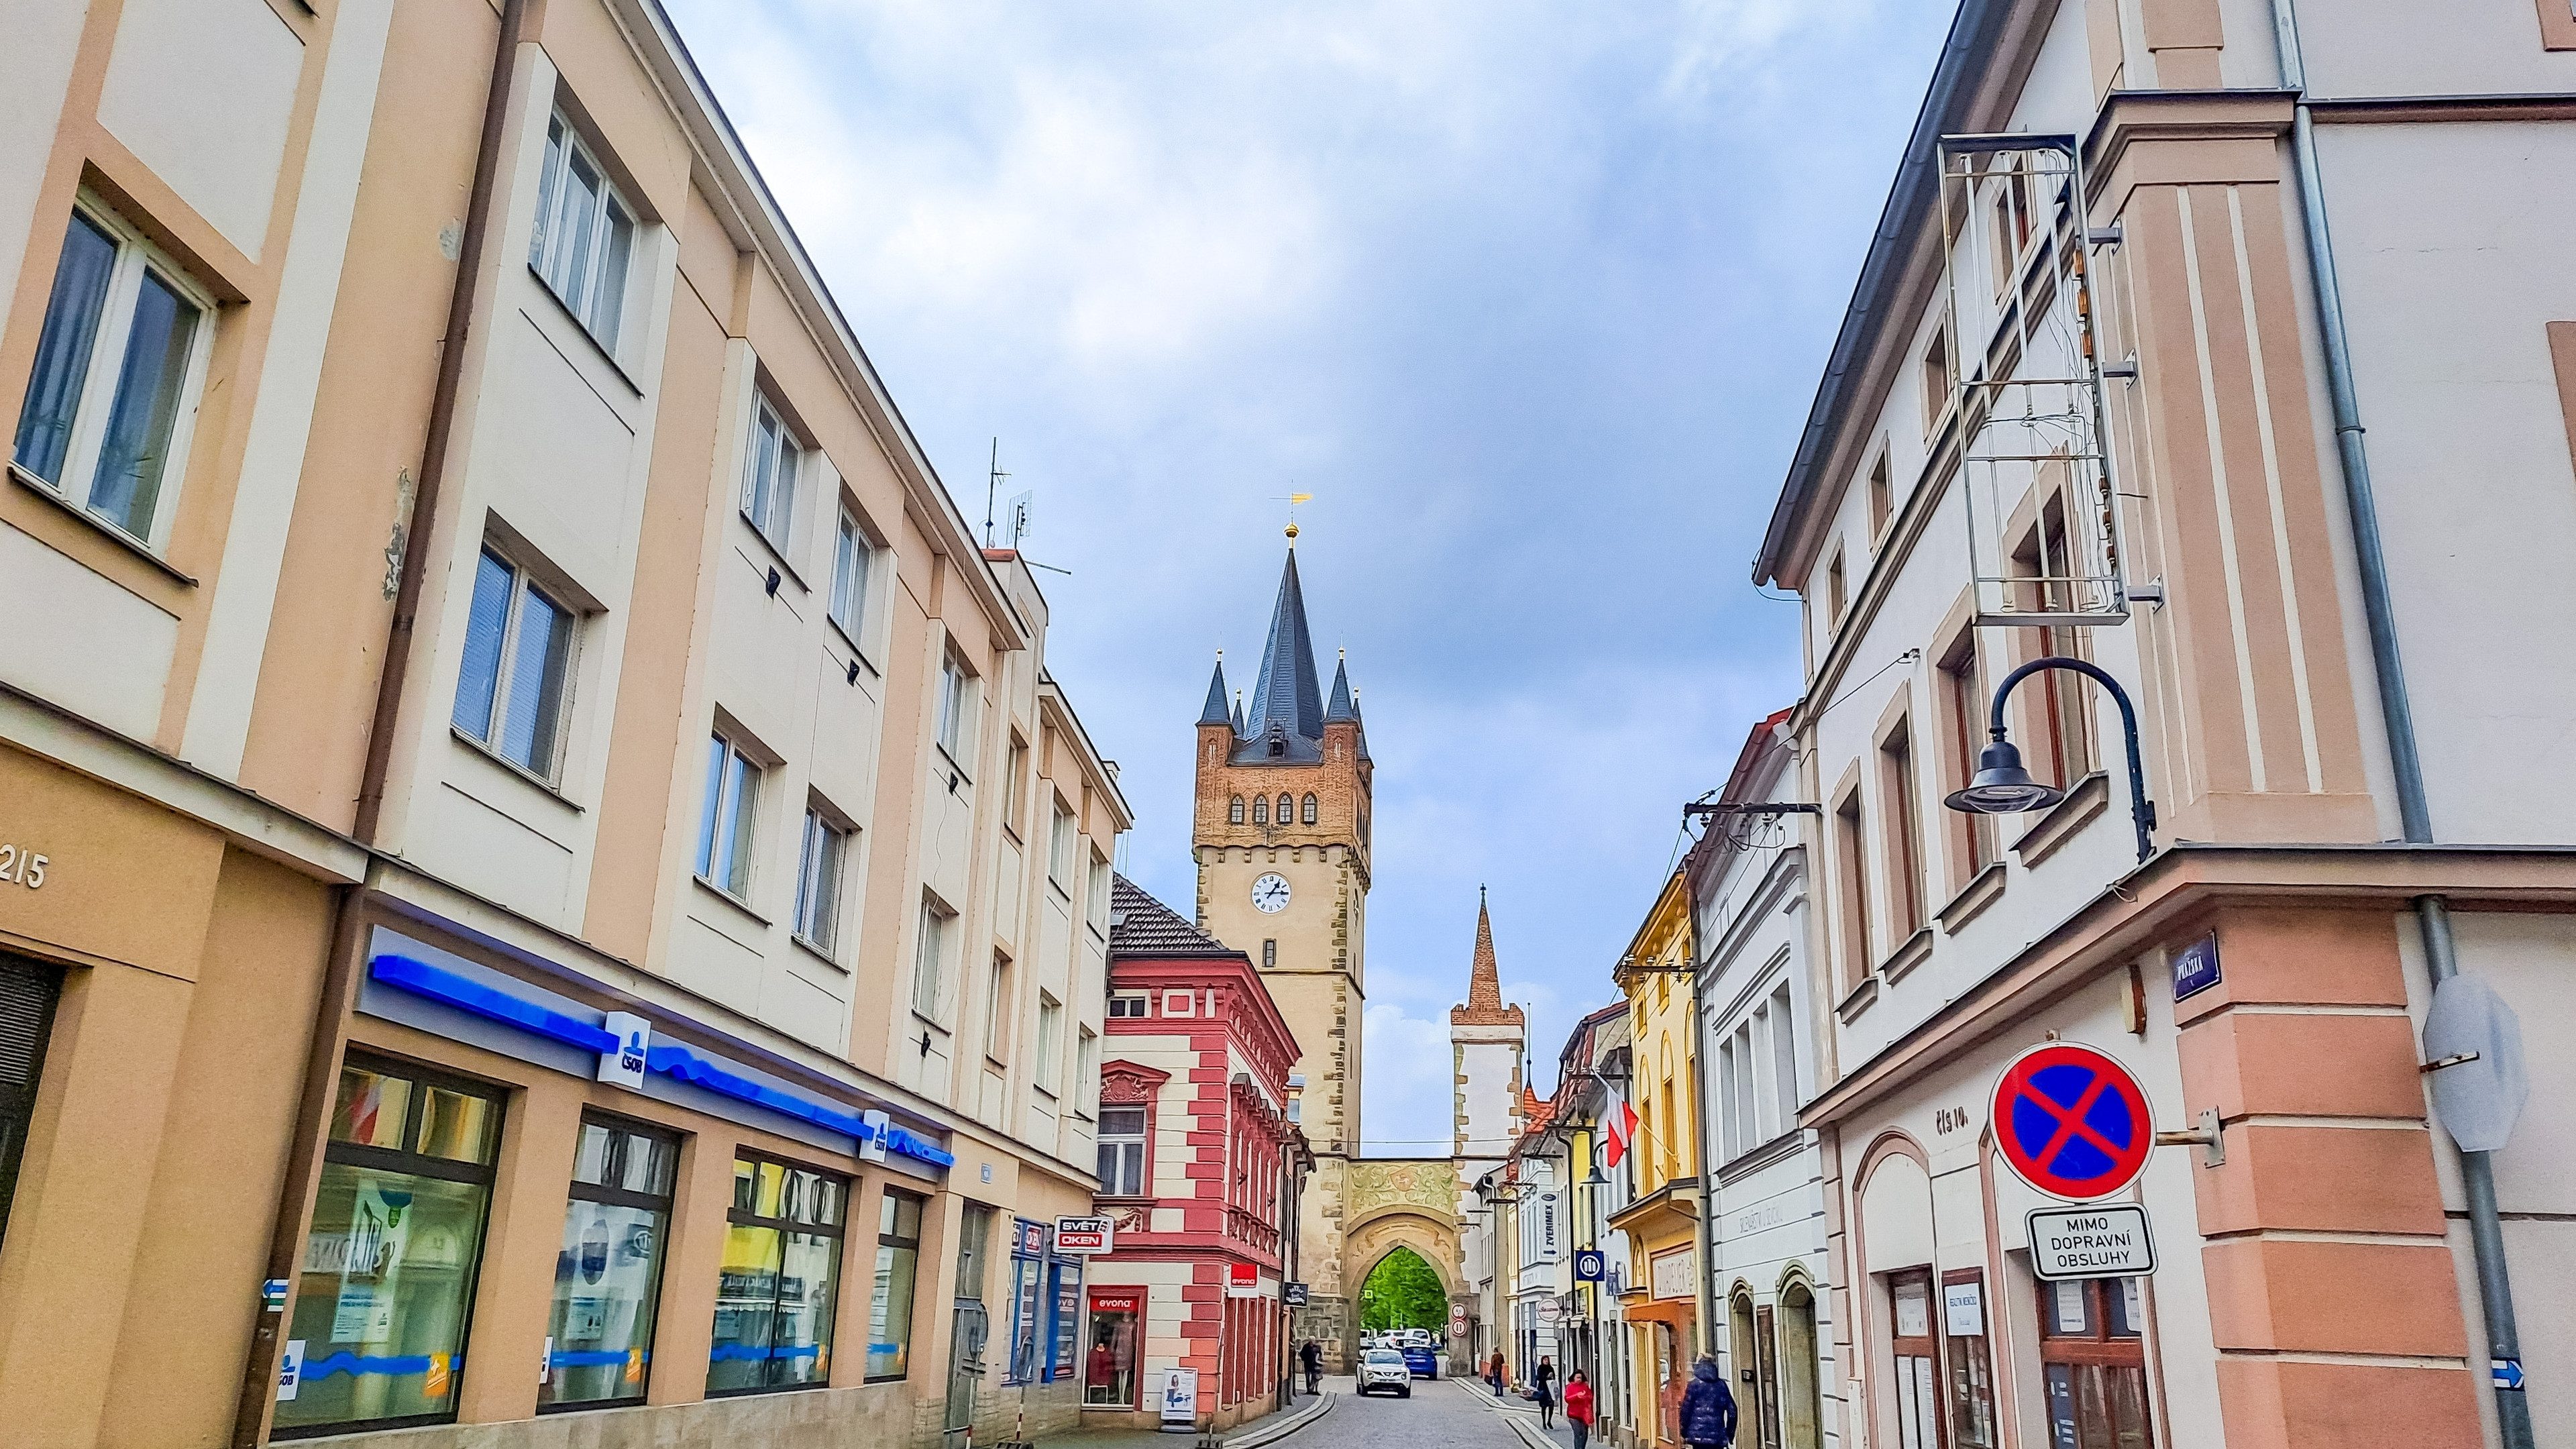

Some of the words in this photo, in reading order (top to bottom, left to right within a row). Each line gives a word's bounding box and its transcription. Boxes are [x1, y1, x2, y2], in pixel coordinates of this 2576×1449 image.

[1545, 1205, 1554, 1246] ZVERIMEX
[2067, 1218, 2108, 1232] MIMO
[1061, 1236, 1099, 1244] OKEN
[2051, 1229, 2131, 1250] DOPRAVNÍ
[2057, 1250, 2129, 1267] OBSLUHY
[1099, 1299, 1131, 1307] evona
